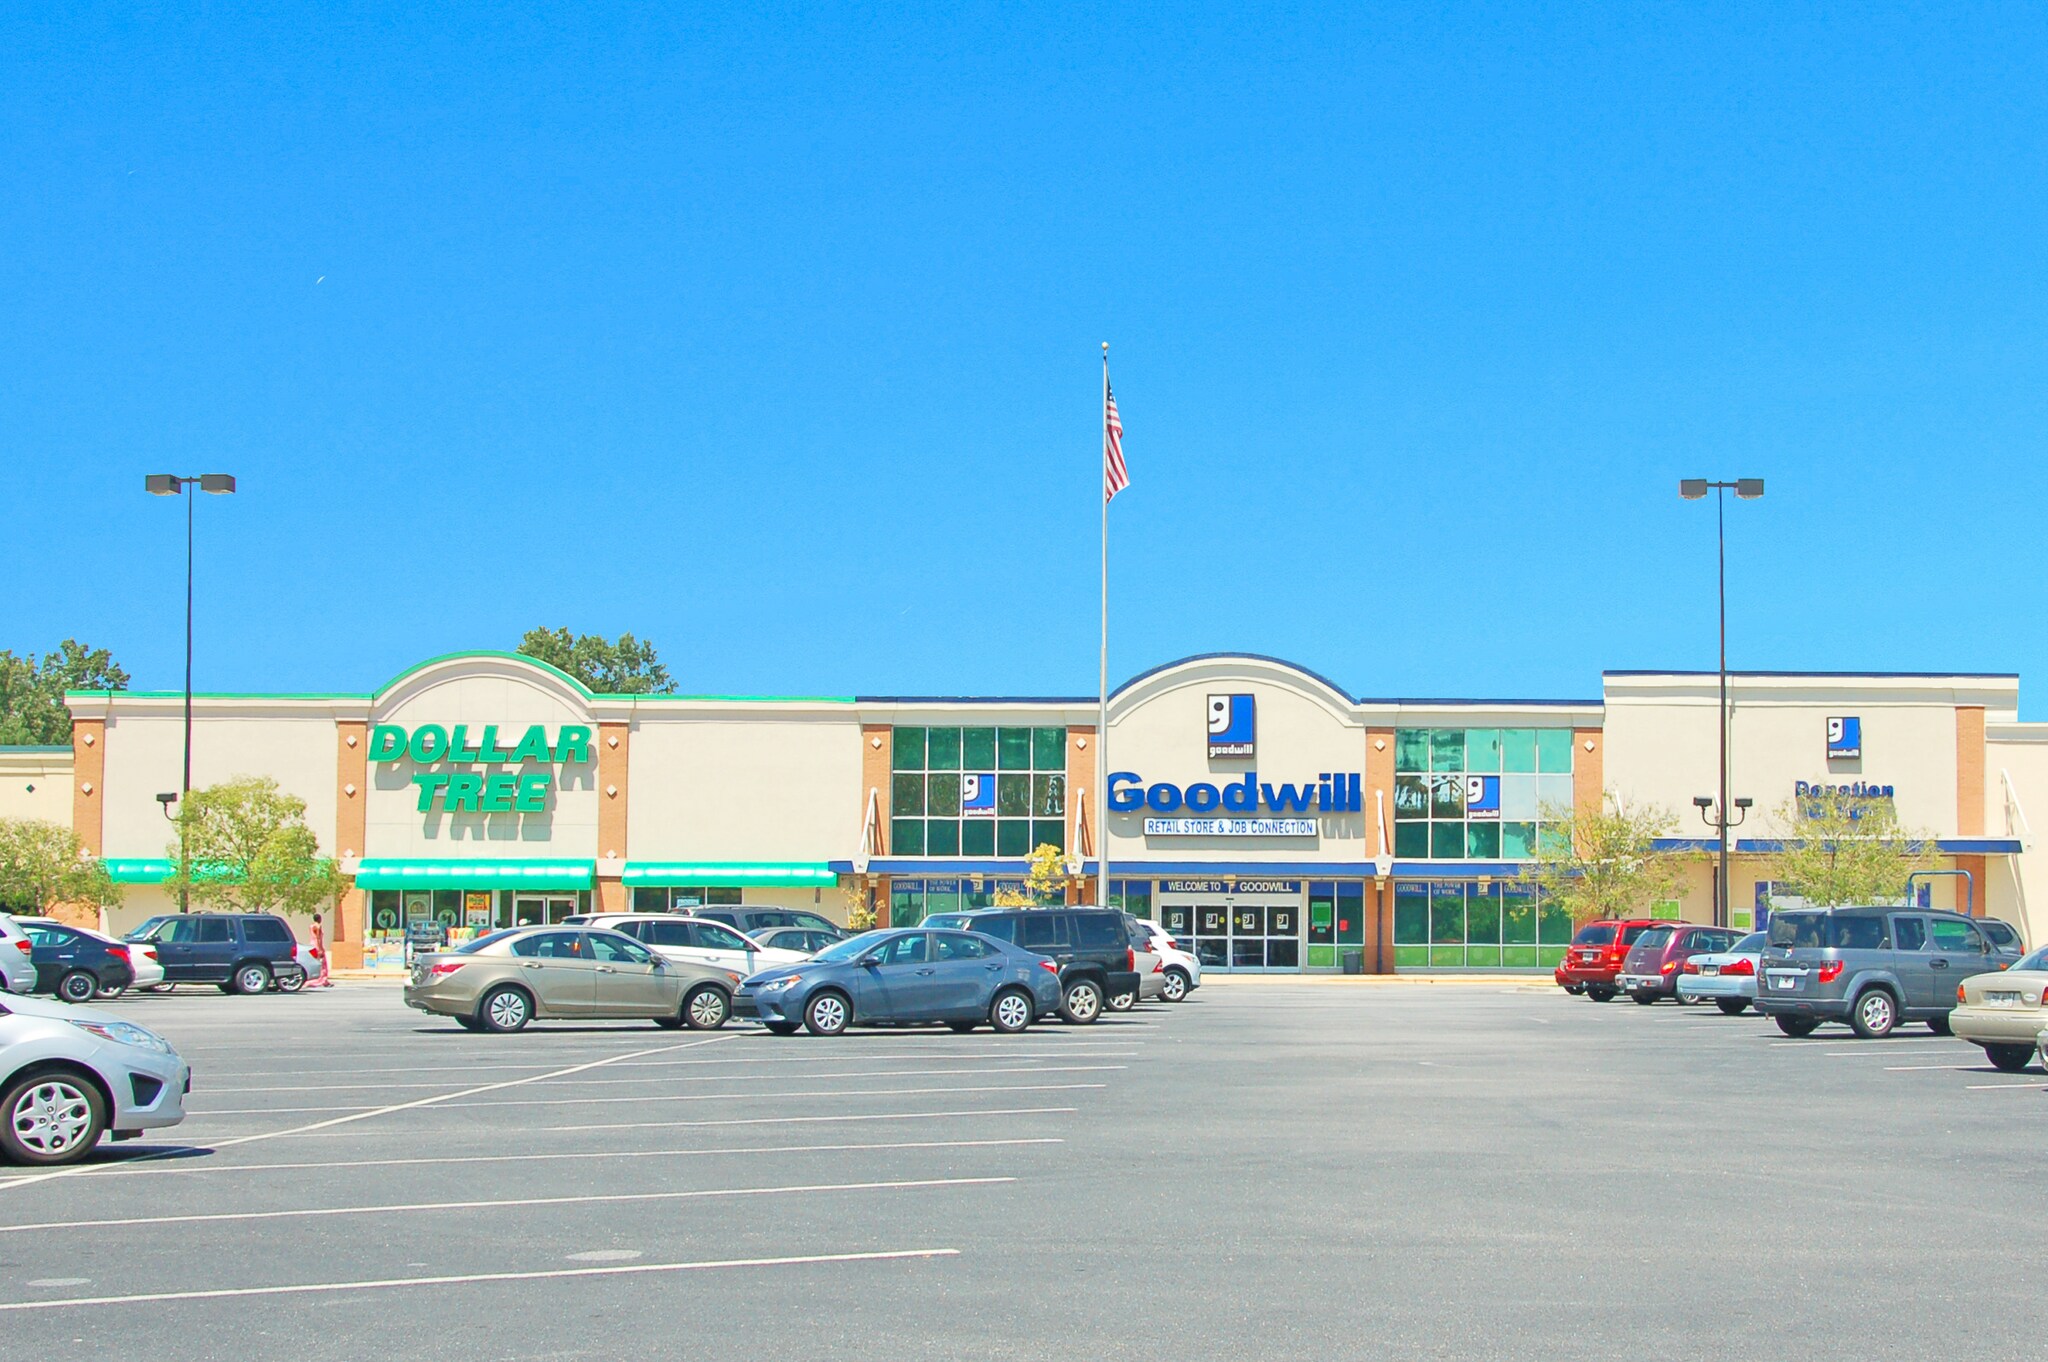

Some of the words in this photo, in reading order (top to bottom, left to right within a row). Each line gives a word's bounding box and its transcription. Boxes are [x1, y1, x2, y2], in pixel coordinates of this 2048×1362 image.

[368, 724, 592, 763] DOLLAR
[1209, 743, 1253, 758] goodwill
[412, 774, 552, 812] TREE
[1107, 771, 1361, 812] Goodwill
[1795, 781, 1894, 798] Donation
[1148, 820, 1180, 833] RETAIL
[1184, 820, 1214, 833] STORE
[1218, 820, 1224, 833] &
[1228, 820, 1247, 833] JOB
[1251, 820, 1313, 834] CONNECTION
[1168, 881, 1209, 891] WELCOME
[1210, 881, 1221, 891] TO
[1239, 881, 1292, 892] GOODWILL
